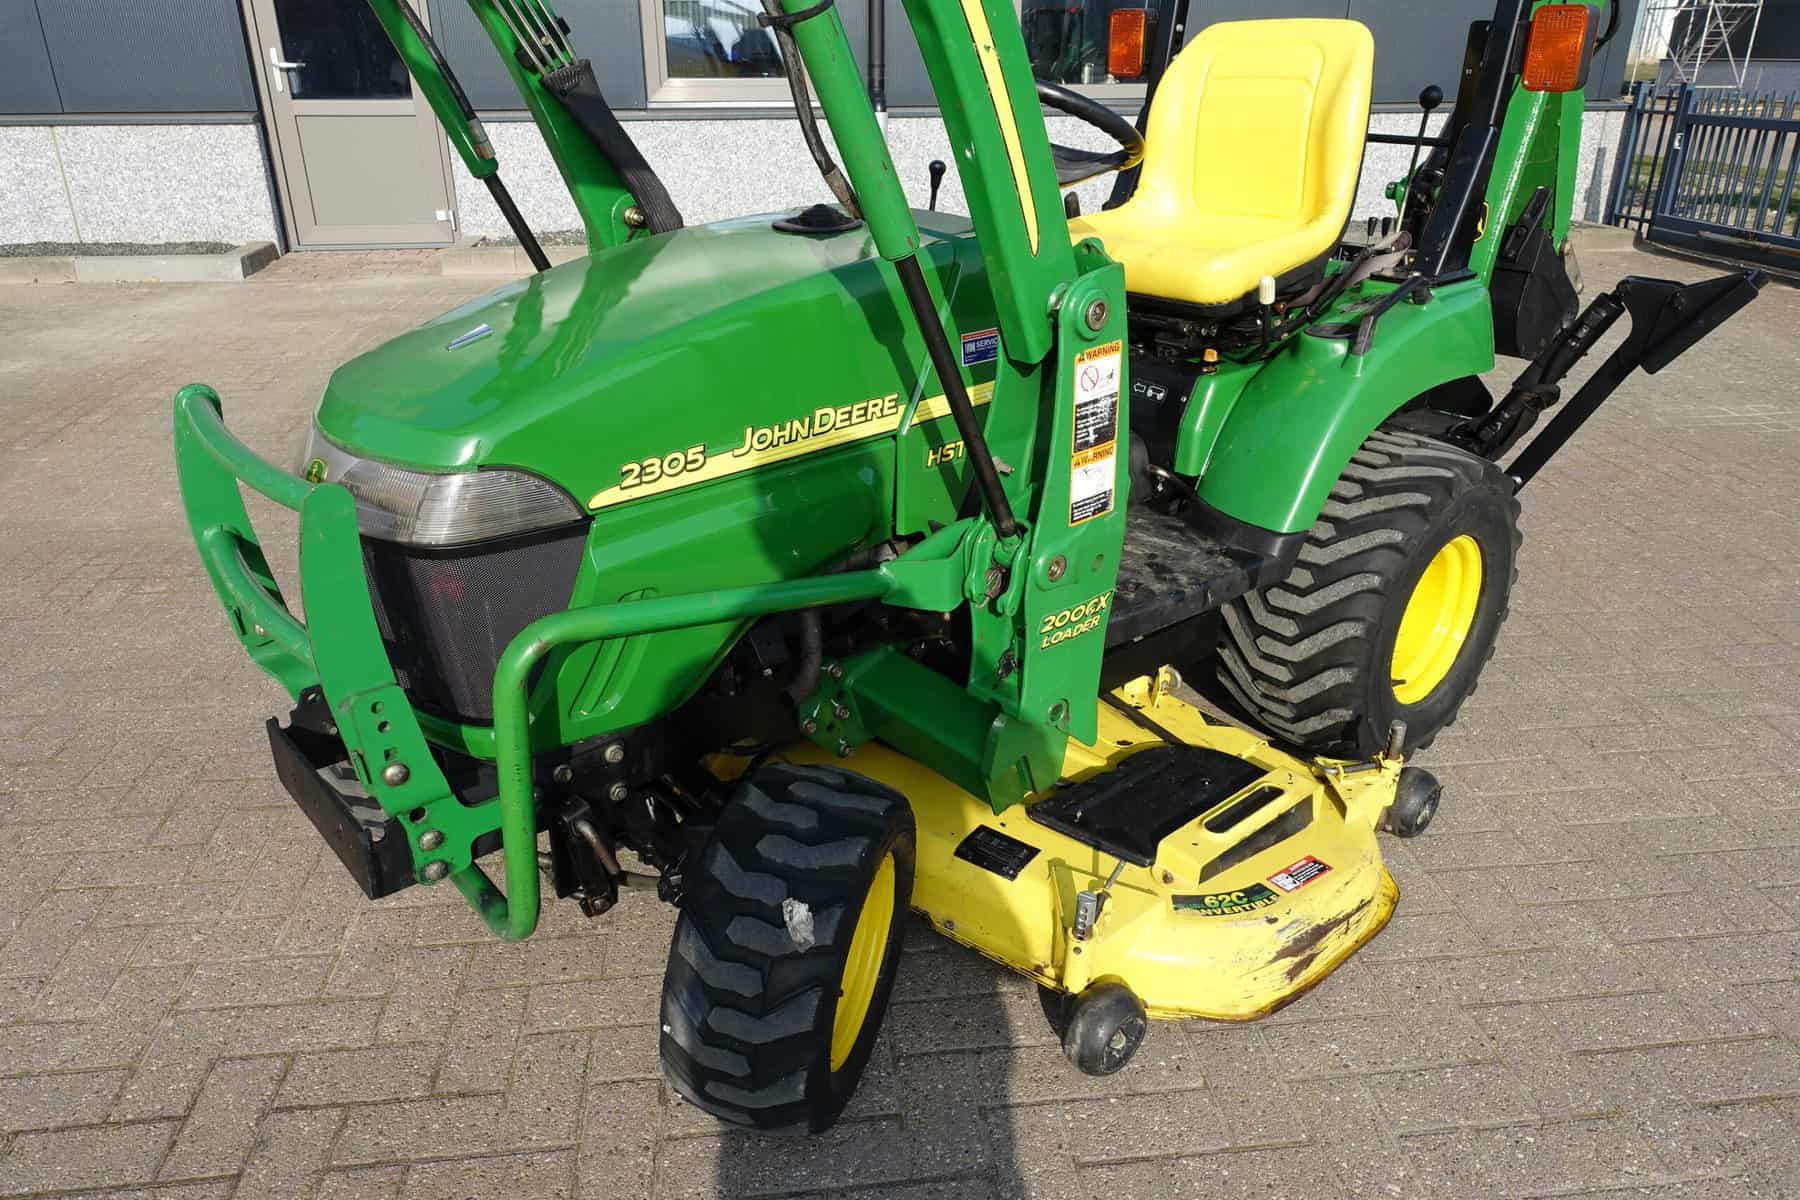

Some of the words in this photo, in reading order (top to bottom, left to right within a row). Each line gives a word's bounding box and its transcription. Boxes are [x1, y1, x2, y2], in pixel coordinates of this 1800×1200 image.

[976, 336, 999, 348] SERVIC
[1085, 341, 1121, 360] WARNING
[733, 415, 811, 458] JOHN
[812, 392, 900, 435] DEERE
[926, 440, 966, 468] HST
[1080, 445, 1114, 465] WRNING
[619, 443, 706, 490] 2305
[1040, 613, 1101, 650] LOADER
[1203, 891, 1250, 909] 62C
